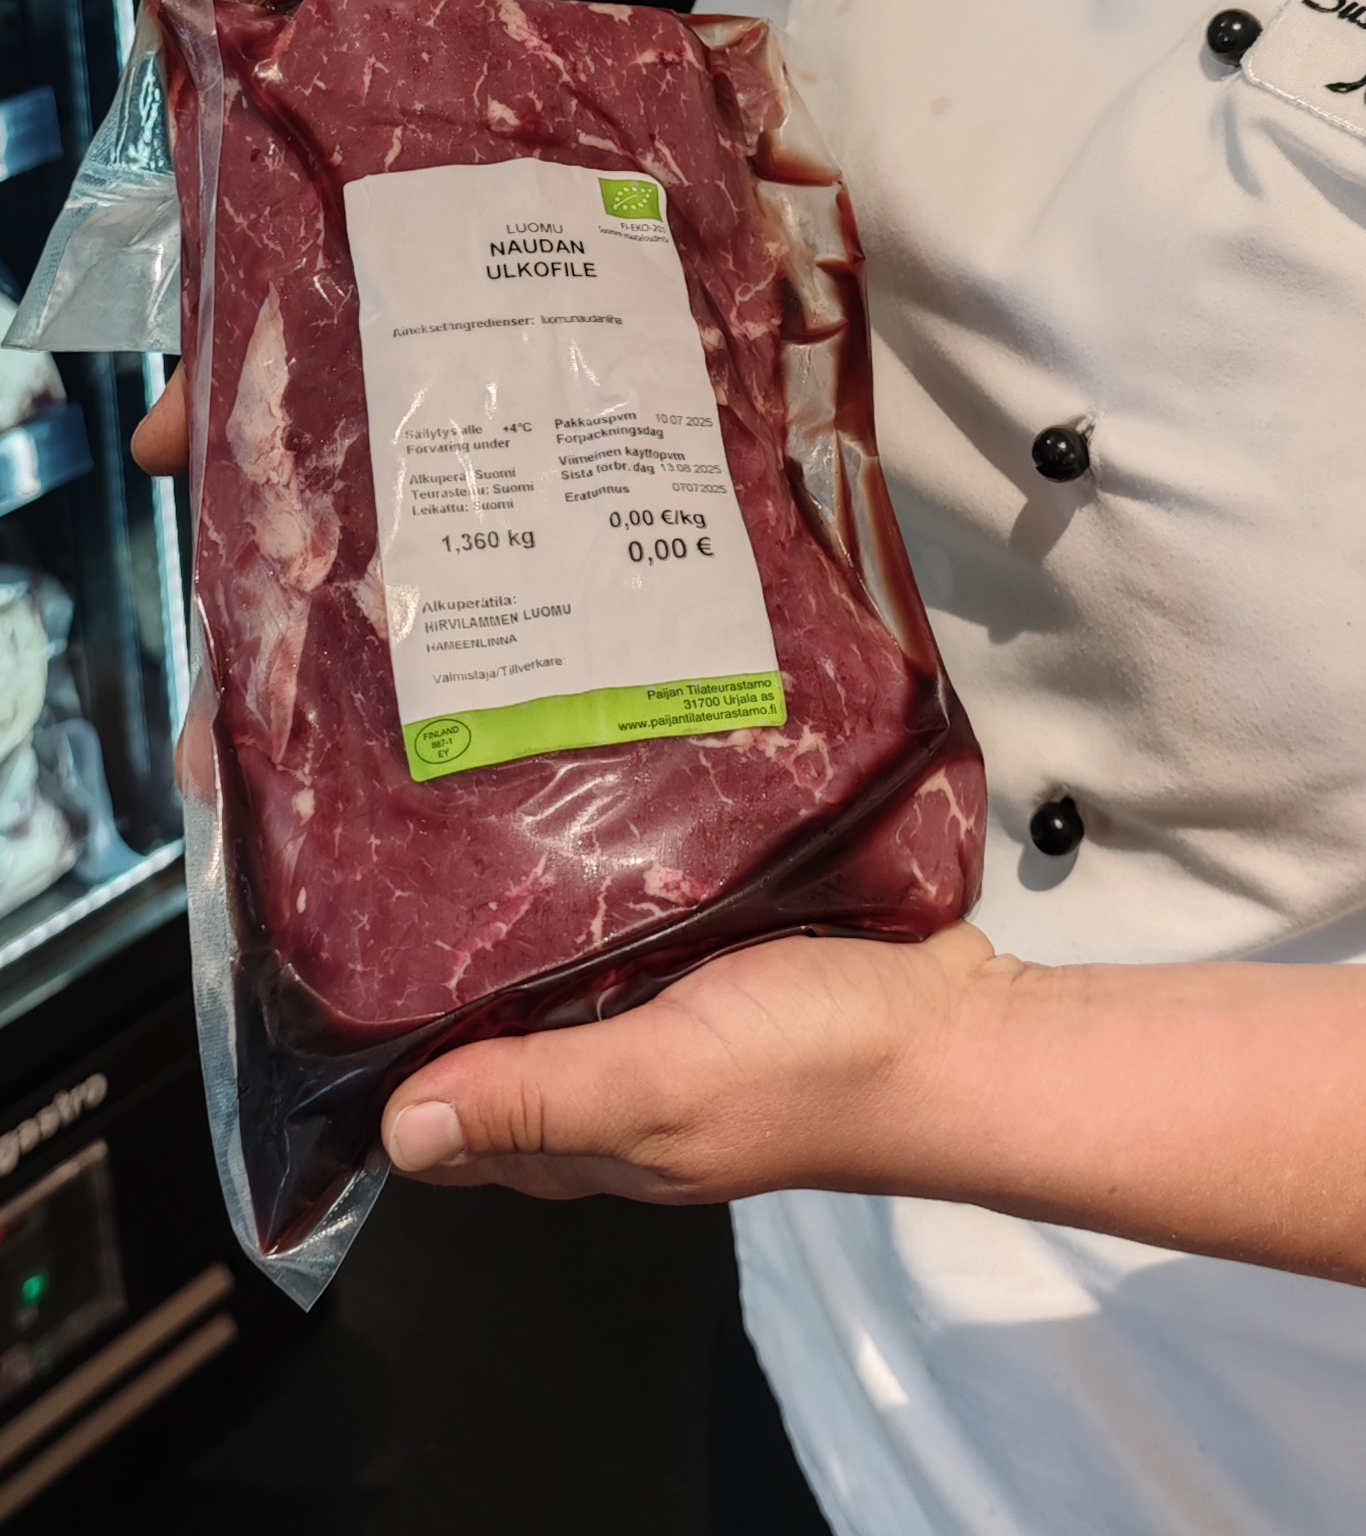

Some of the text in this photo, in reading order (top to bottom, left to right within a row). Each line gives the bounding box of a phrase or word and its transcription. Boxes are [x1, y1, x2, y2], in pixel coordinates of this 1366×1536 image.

[505, 222, 564, 235] LUOMU
[489, 239, 586, 257] NAUDAN
[486, 261, 598, 280] ULKOFILE
[461, 424, 484, 436] alle
[554, 412, 638, 430] Pakkauspvm
[473, 438, 511, 451] under
[474, 467, 517, 481] Suomi
[560, 469, 594, 481] Sista
[634, 462, 656, 476] dag
[492, 481, 535, 495] Suomi
[412, 497, 515, 517] Leikattu: Suomi
[609, 509, 708, 531] 0,00 €/kg
[441, 529, 536, 555] 1,360 kg
[628, 536, 715, 567] 0,00 €
[424, 603, 572, 634] HIRVILAMMEN LUOMU
[686, 679, 772, 696] Tilateurastamo
[683, 692, 775, 710] 31700 Urjala as
[618, 704, 778, 732] www.paijantilateurastamo.fi
[423, 725, 460, 741] FINLAND
[437, 748, 450, 759] EY
